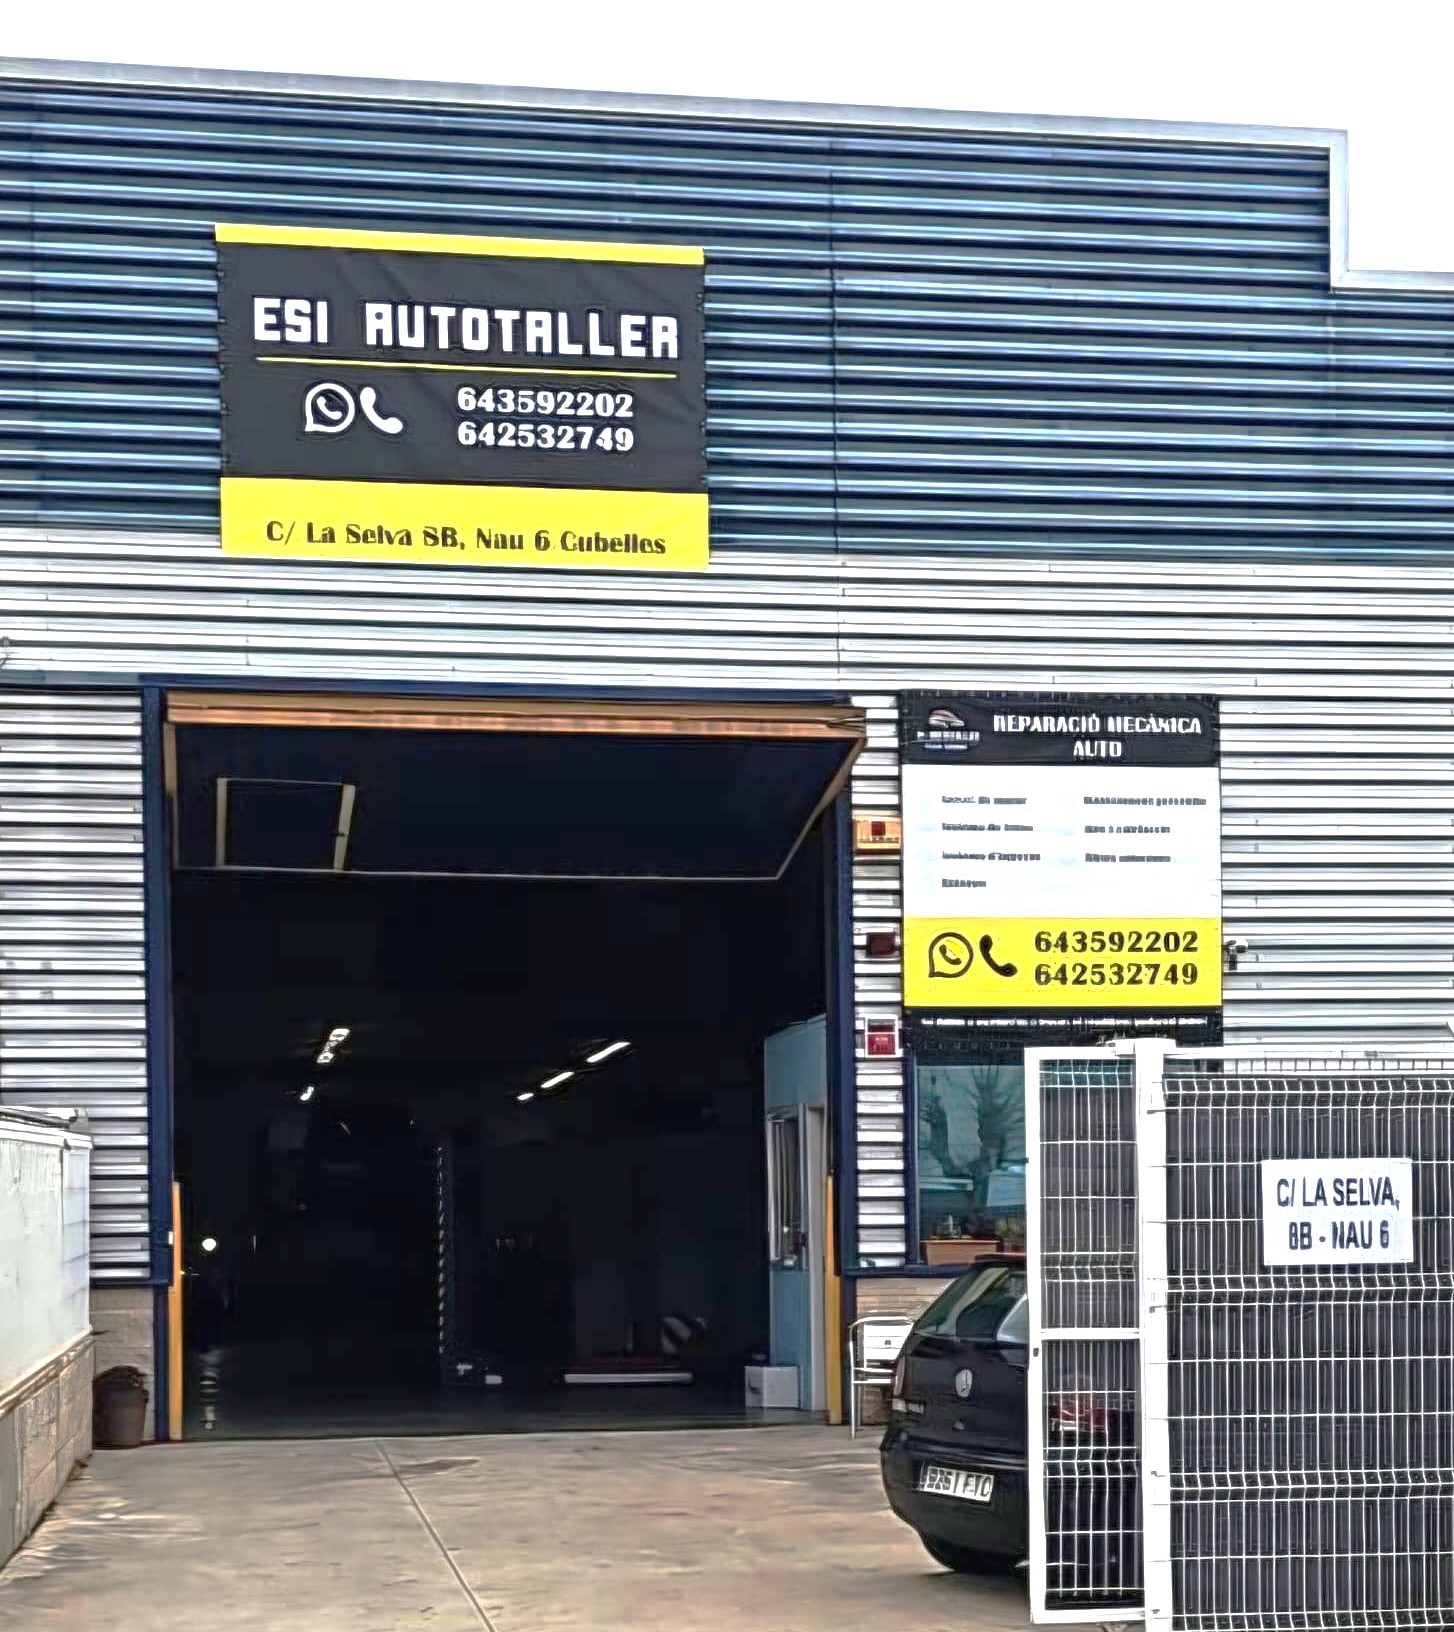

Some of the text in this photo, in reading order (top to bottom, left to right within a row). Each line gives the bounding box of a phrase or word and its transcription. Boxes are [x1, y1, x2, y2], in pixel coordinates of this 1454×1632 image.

[253, 296, 679, 359] ESI AUTOTALLER
[457, 387, 633, 418] 643592202
[457, 421, 634, 451] 642532749
[266, 520, 296, 546] C/
[306, 521, 336, 544] La
[345, 523, 413, 546] Selva
[476, 527, 524, 550] Nau
[534, 529, 551, 551] 6
[560, 530, 666, 554] Cubelles
[1072, 740, 1123, 758] AUTO
[1034, 930, 1199, 953] 643592202
[1034, 962, 1199, 986] 642532749
[1276, 1176, 1400, 1211] C/ LA SELVA,
[1288, 1221, 1313, 1251] 8B
[1331, 1219, 1373, 1250] NAU
[1379, 1219, 1390, 1249] 6
